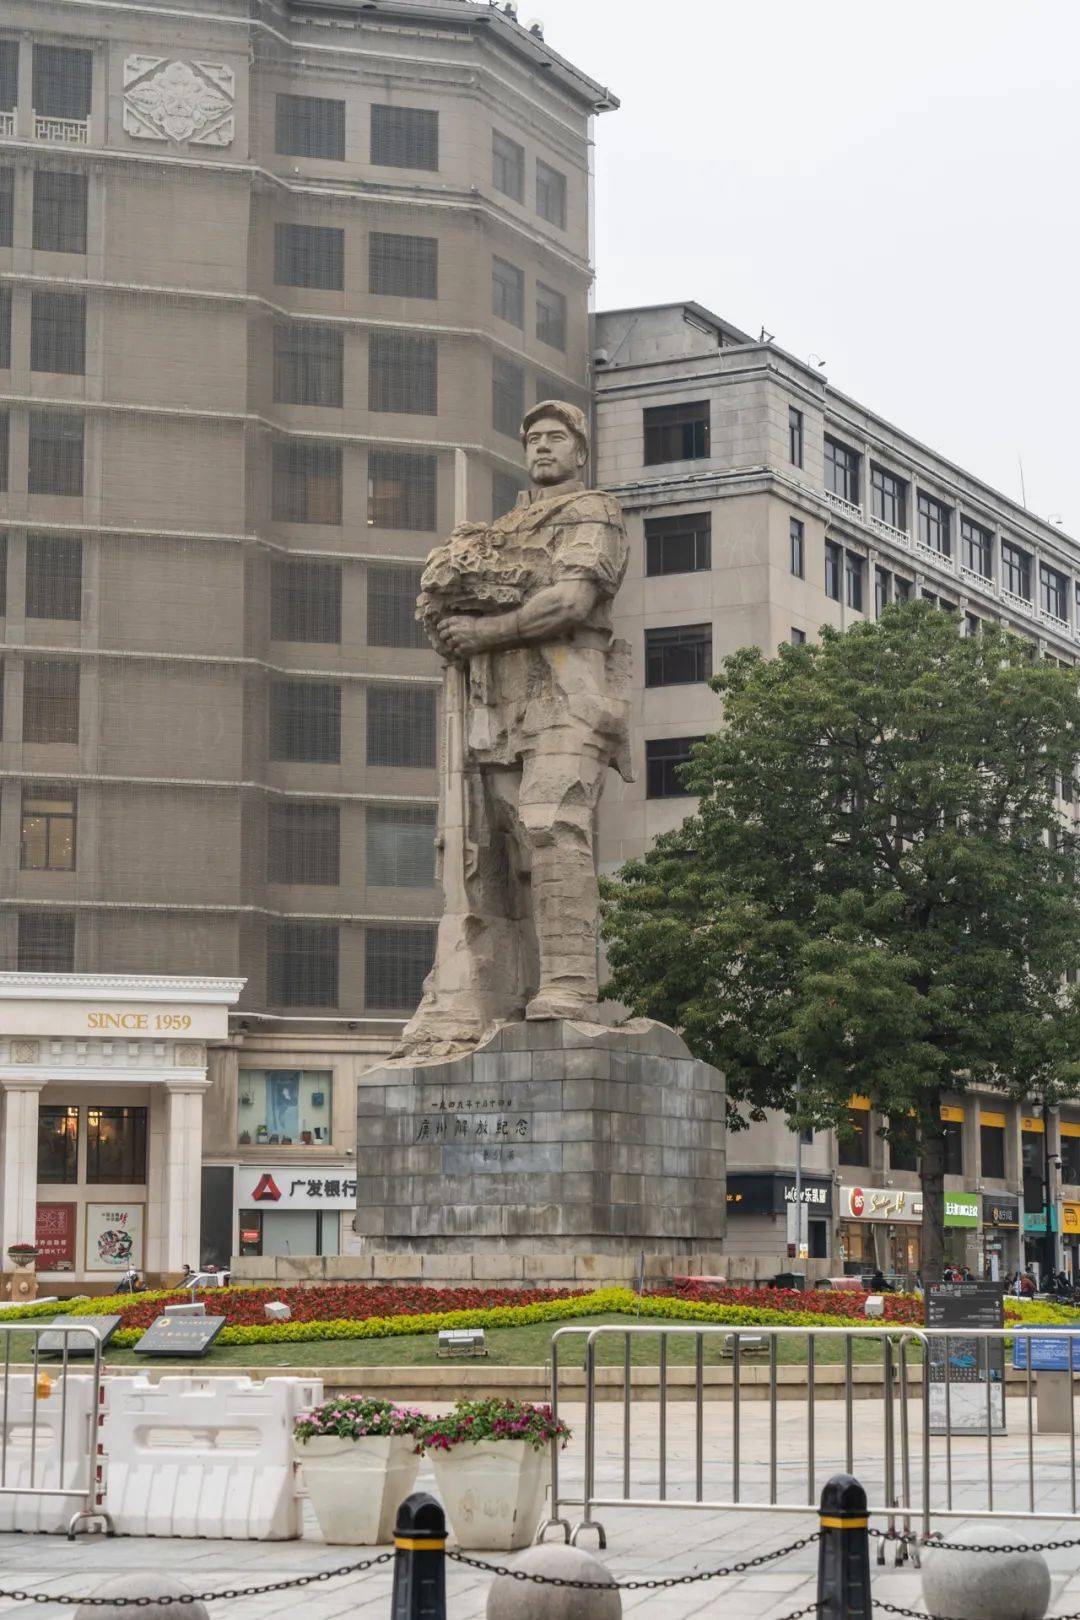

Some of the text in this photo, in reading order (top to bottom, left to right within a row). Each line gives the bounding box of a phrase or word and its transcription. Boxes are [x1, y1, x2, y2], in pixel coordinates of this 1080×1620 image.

[87, 1012, 192, 1030] SINCE 1959
[289, 1179, 357, 1197] 广发银行
